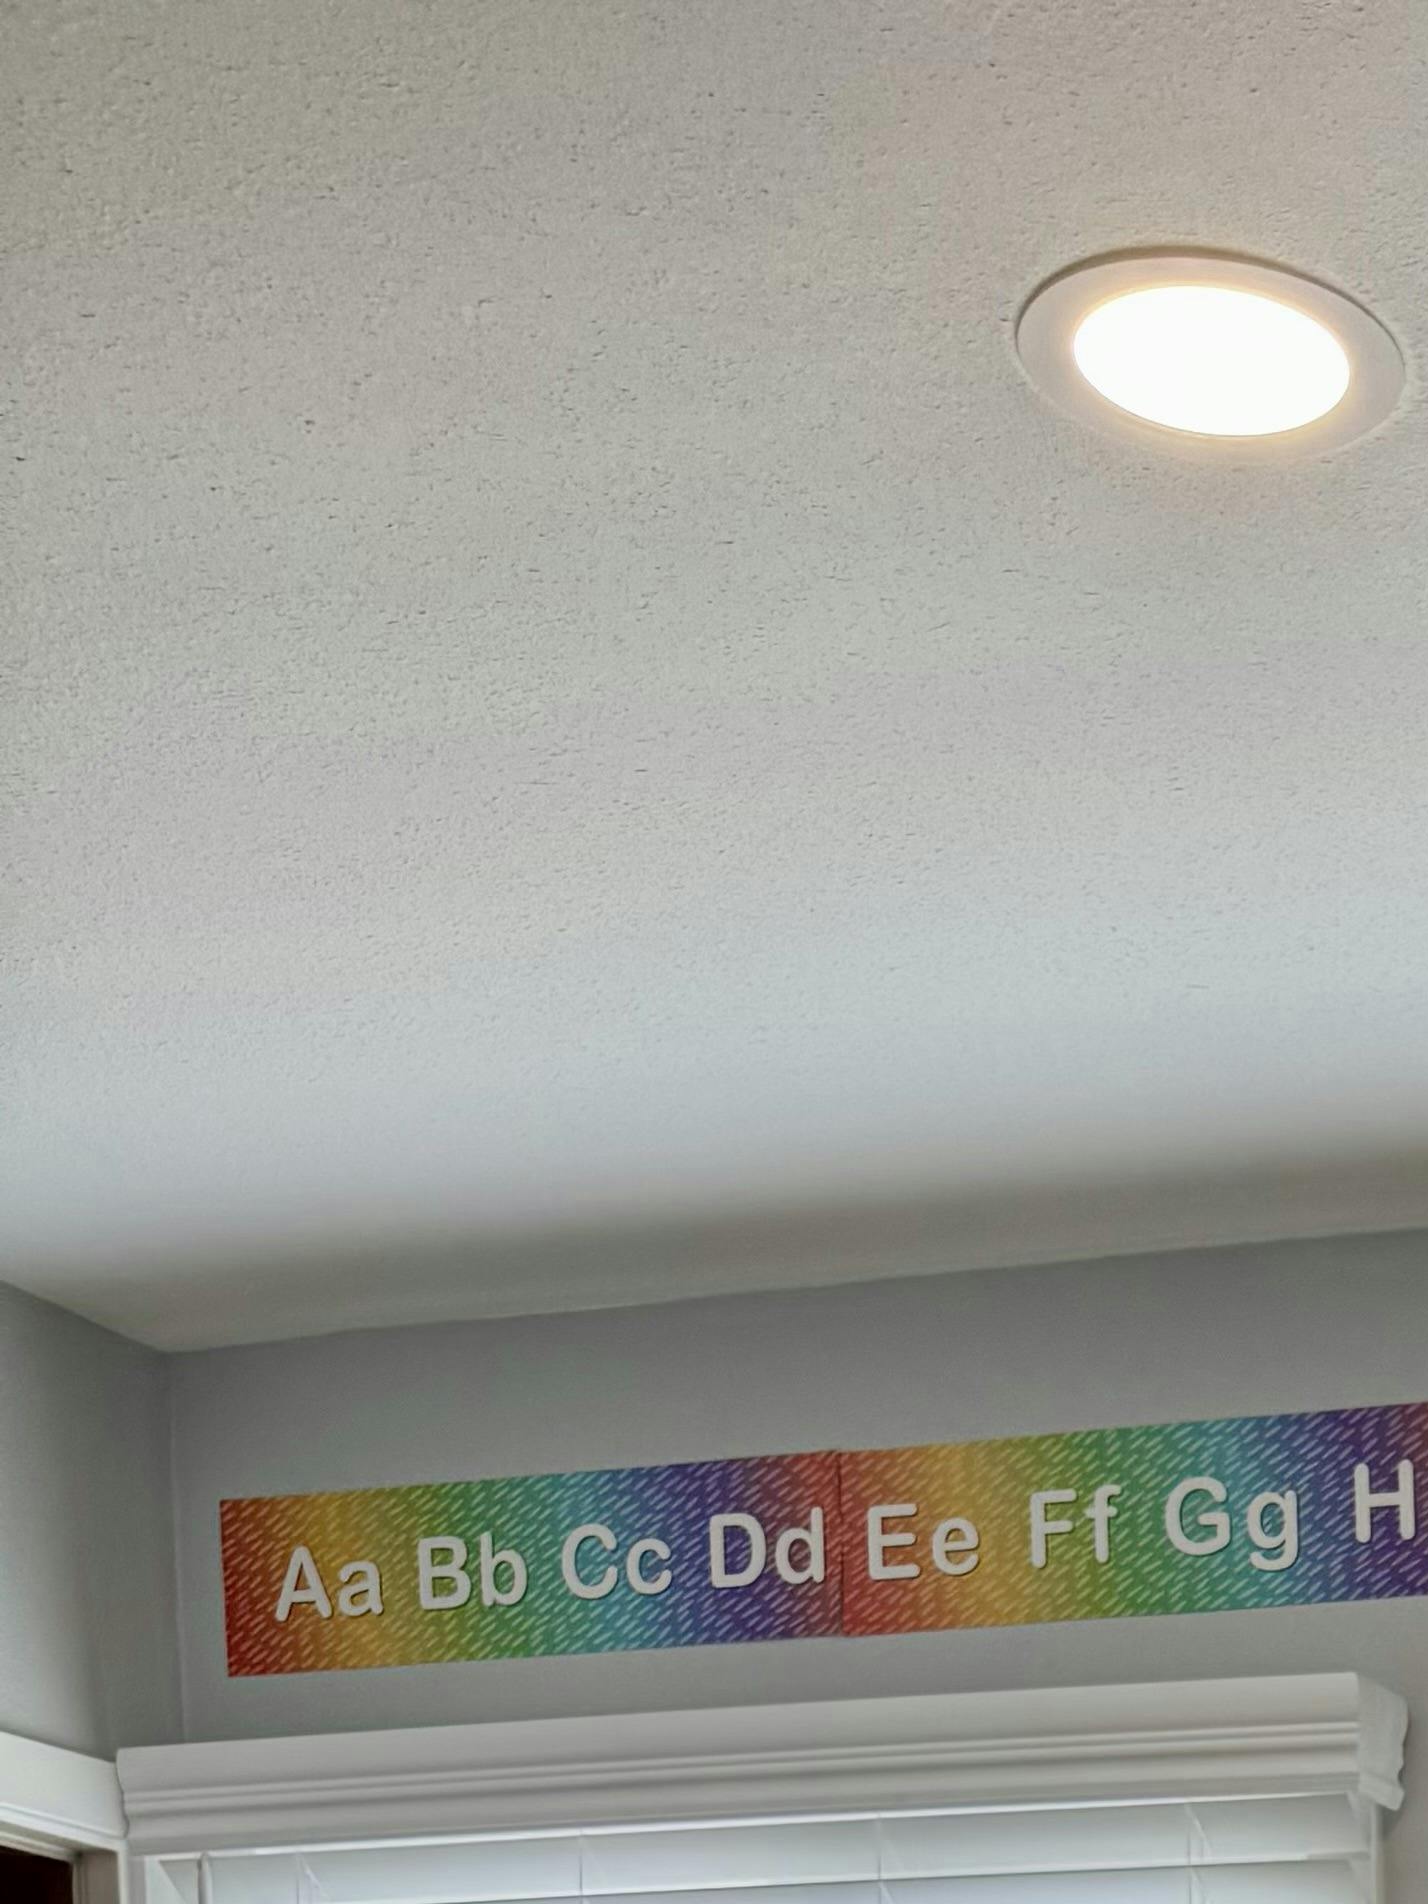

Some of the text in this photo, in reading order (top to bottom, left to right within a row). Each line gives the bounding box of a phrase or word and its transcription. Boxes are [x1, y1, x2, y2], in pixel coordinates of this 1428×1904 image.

[277, 1548, 381, 1620] Aa
[418, 1532, 526, 1608] Bb
[562, 1524, 671, 1598] Cc
[709, 1508, 824, 1587] Dd
[868, 1504, 977, 1579] Ee
[1030, 1484, 1120, 1566] Ff
[1165, 1476, 1297, 1570] Gg
